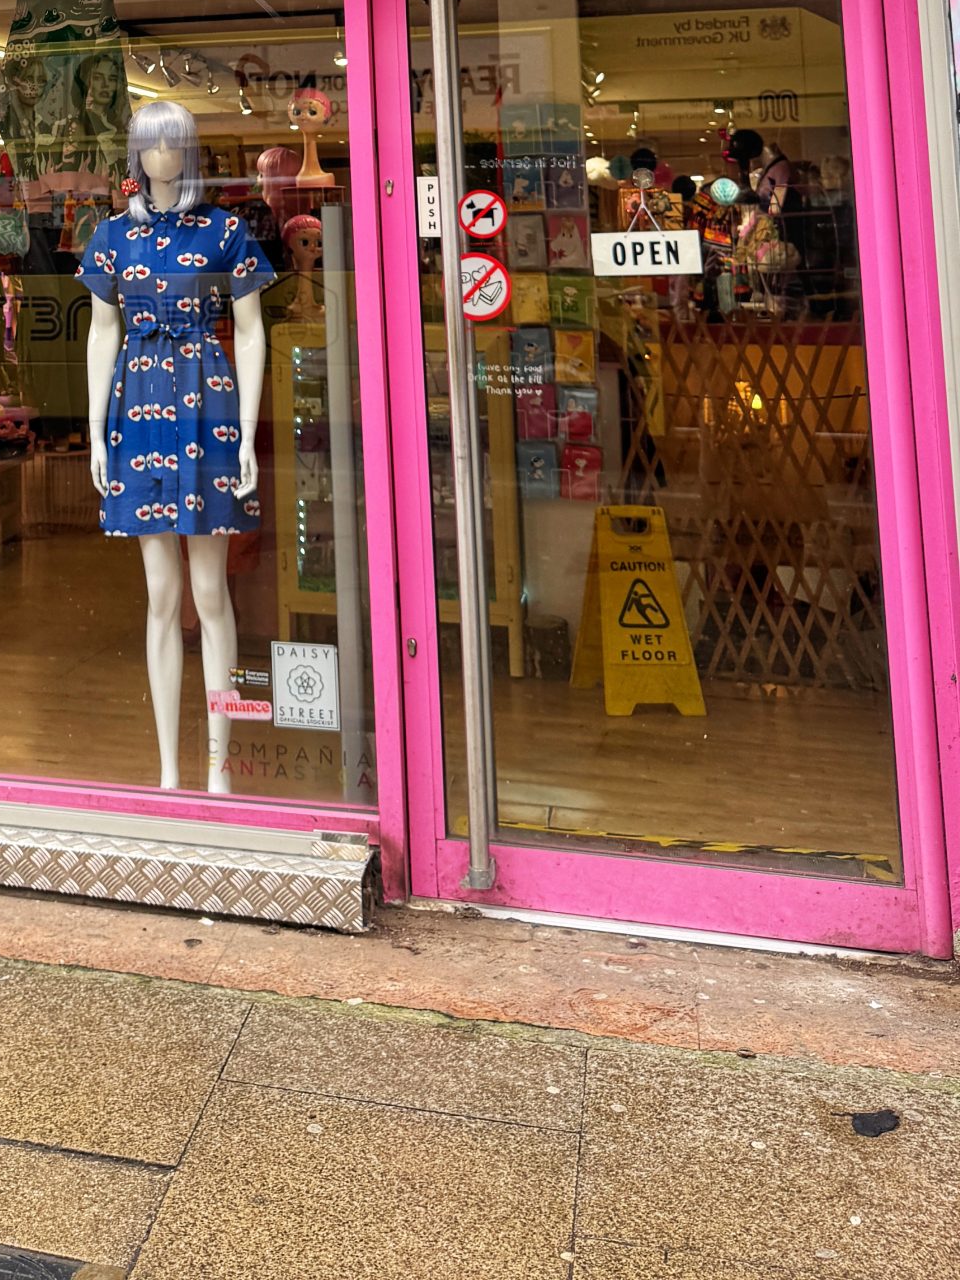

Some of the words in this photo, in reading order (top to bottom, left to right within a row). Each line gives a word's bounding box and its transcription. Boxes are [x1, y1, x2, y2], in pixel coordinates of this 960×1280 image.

[427, 183, 437, 230] PUSH
[612, 240, 680, 267] OPEN
[610, 560, 666, 572] CAUTION
[629, 634, 664, 646] WET
[276, 645, 331, 660] DAISY
[621, 649, 678, 662] FLOOR
[278, 705, 335, 720] STREET
